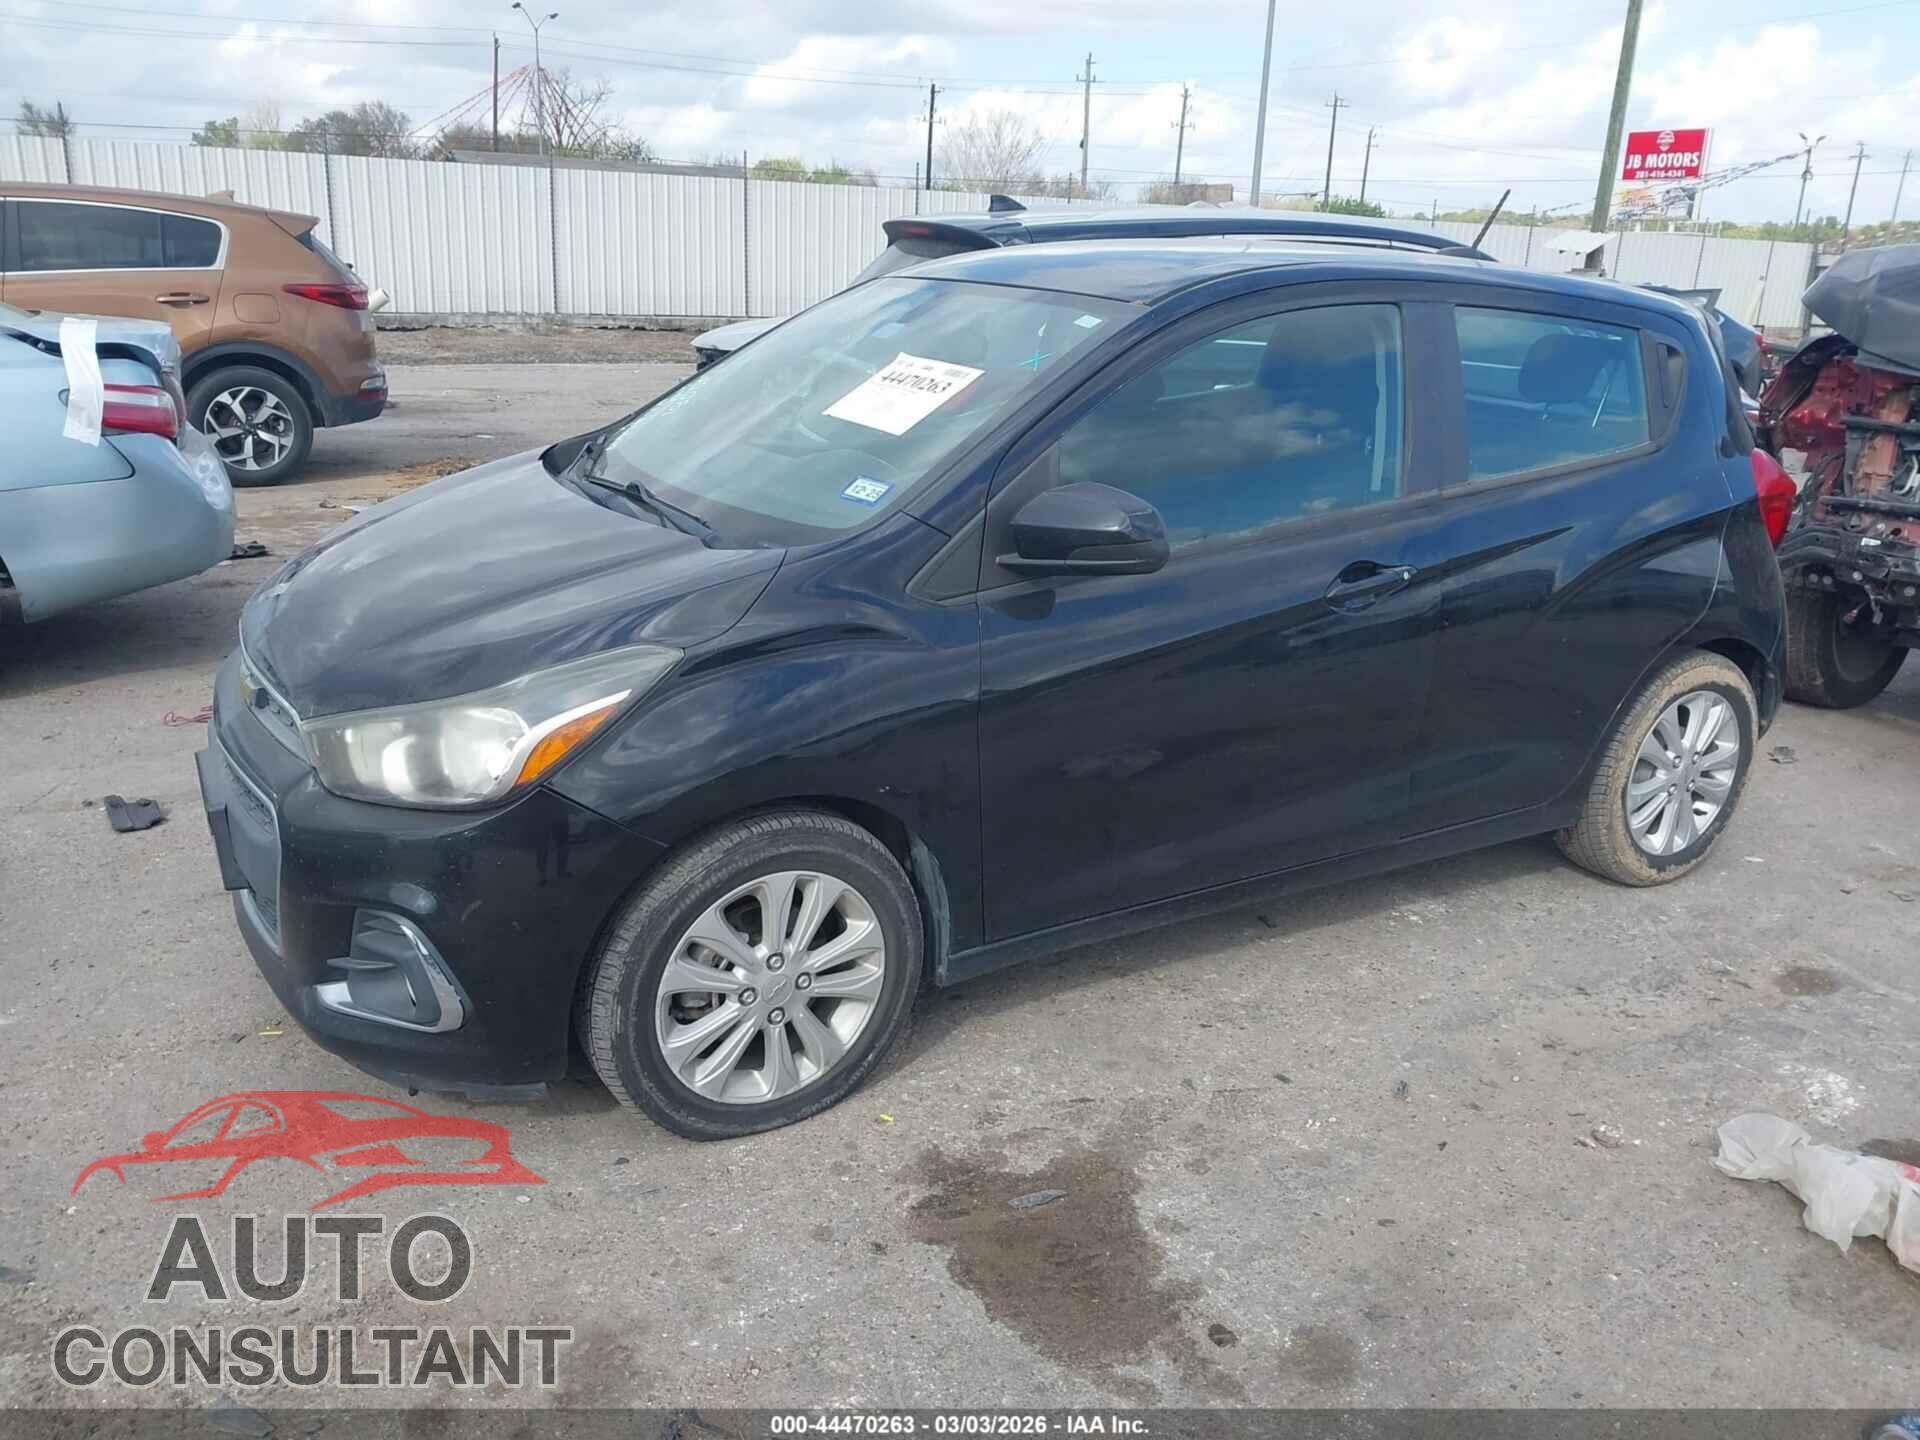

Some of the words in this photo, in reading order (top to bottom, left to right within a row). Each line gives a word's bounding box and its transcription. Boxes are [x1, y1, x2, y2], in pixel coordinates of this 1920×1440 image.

[1626, 154, 1642, 168] JB
[1645, 152, 1699, 168] MOTORS
[880, 371, 953, 394] 44470263
